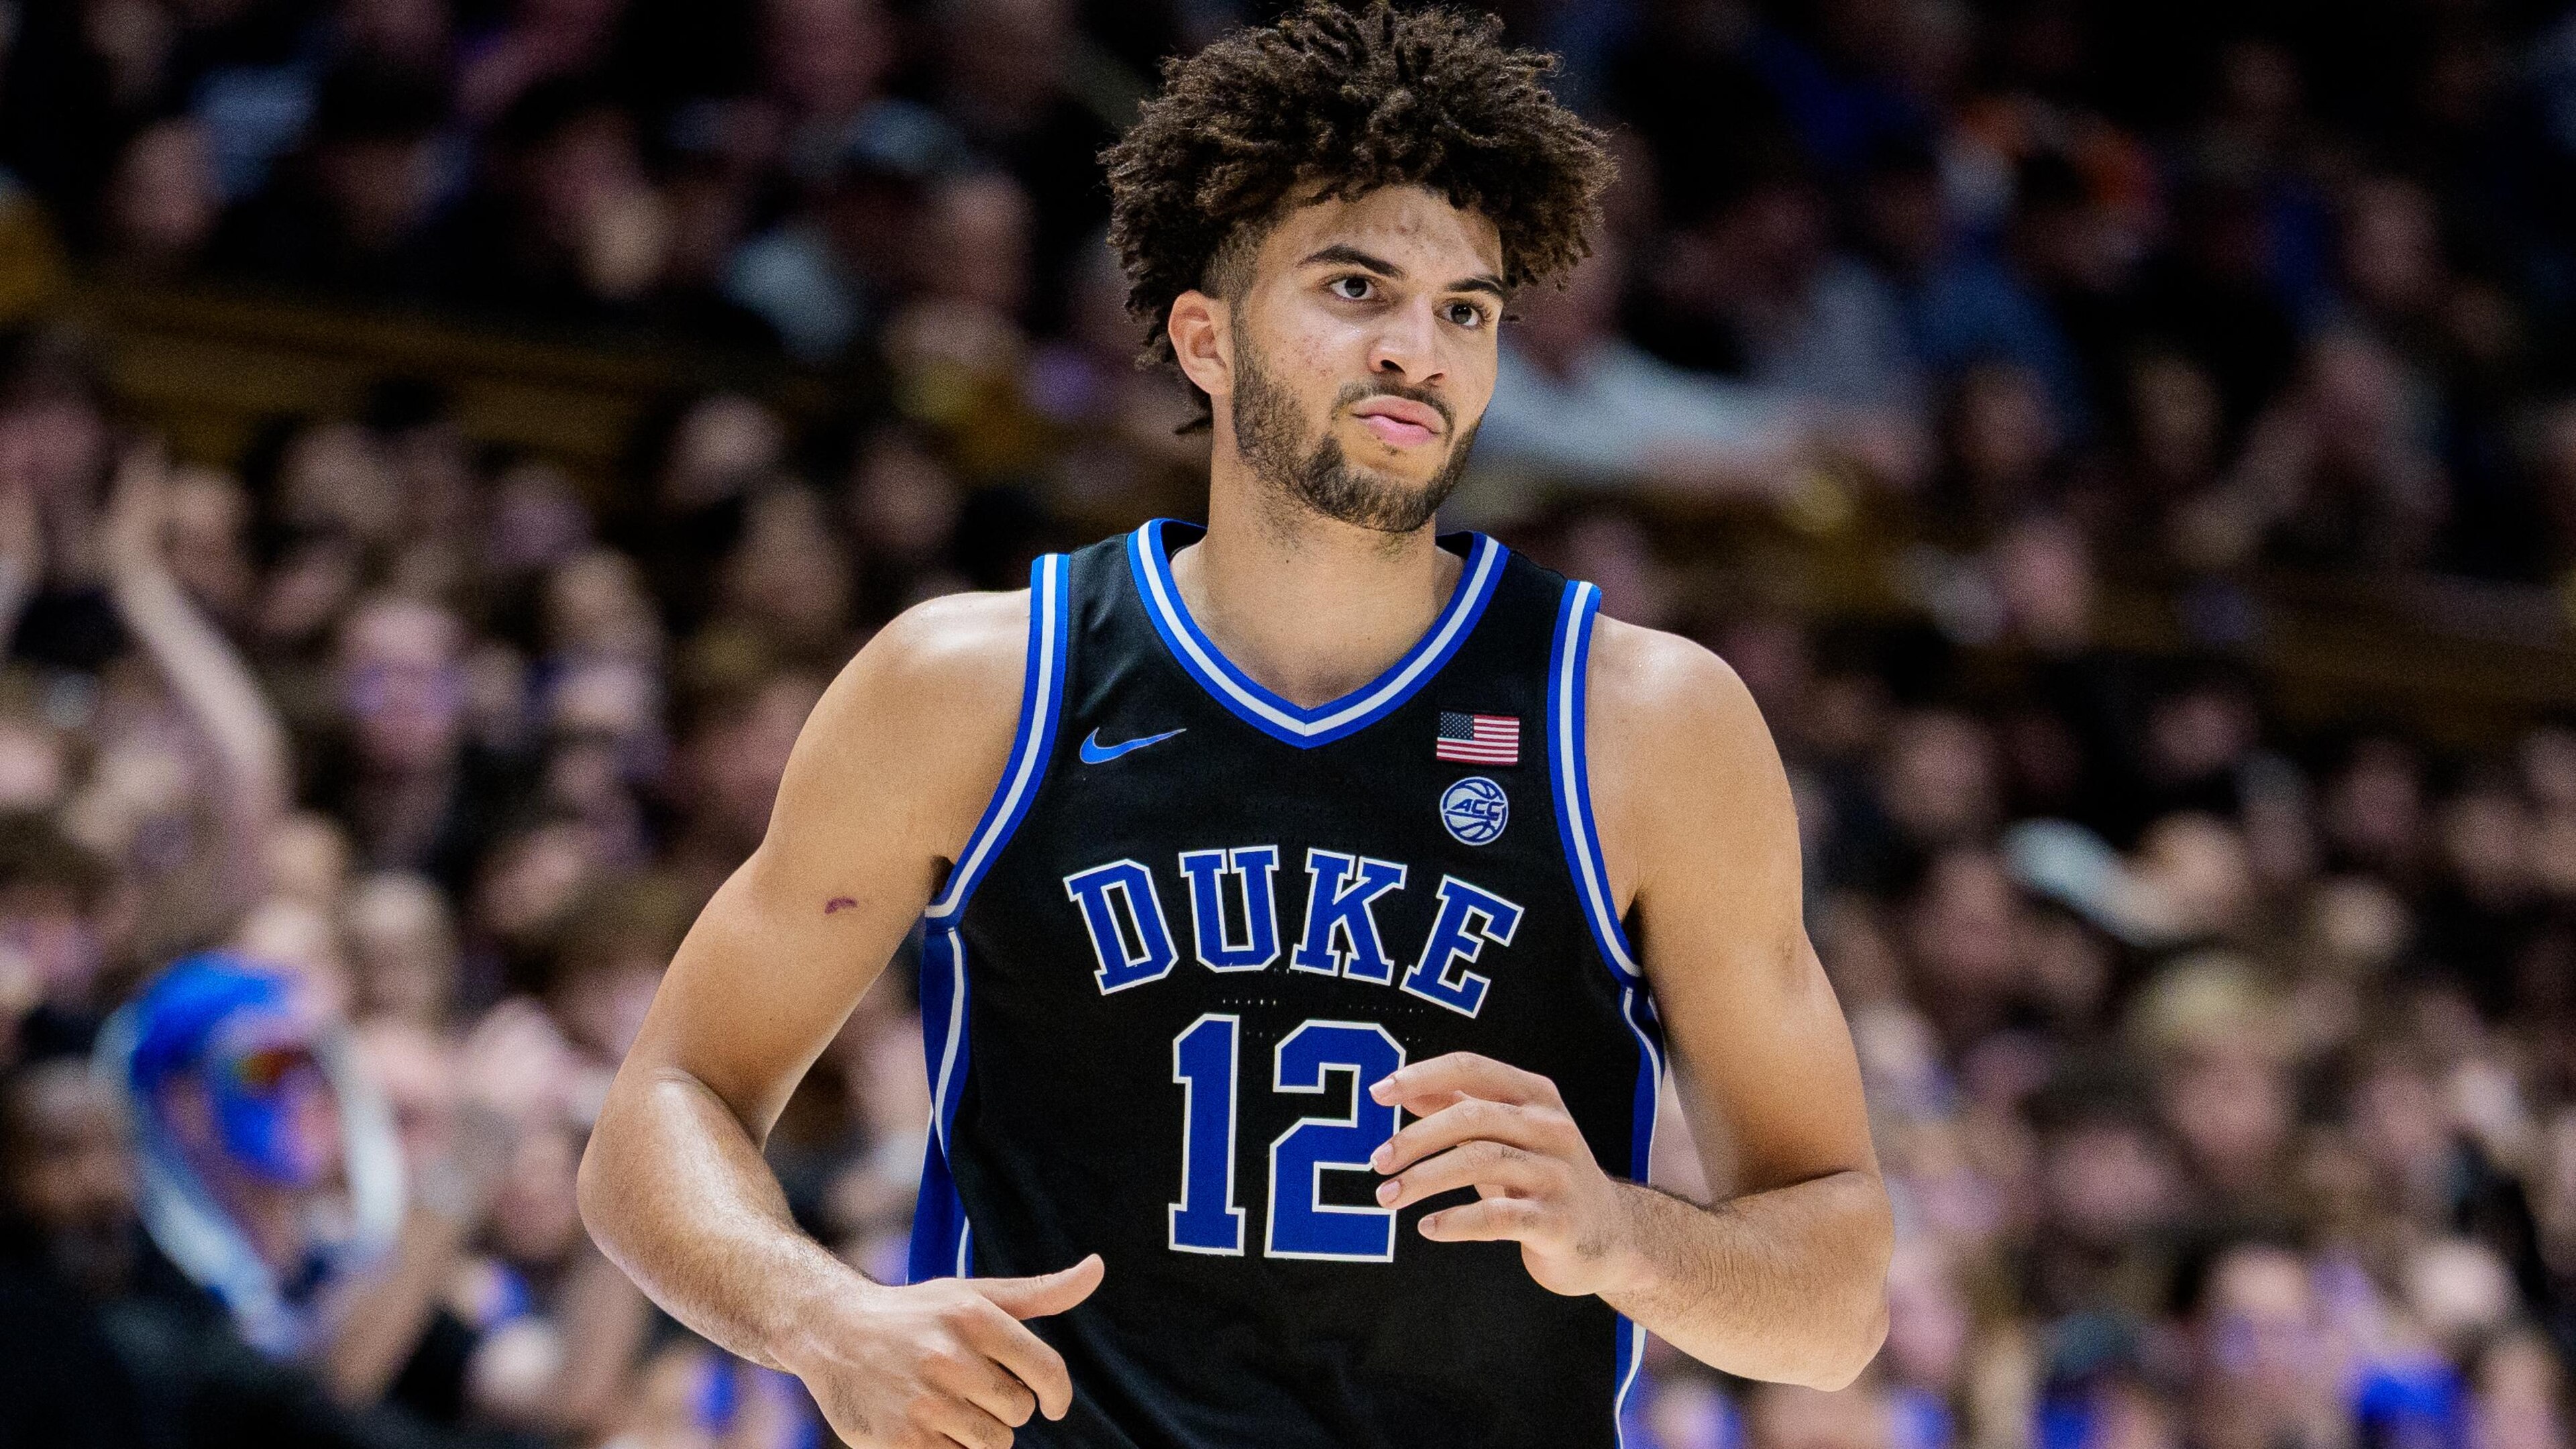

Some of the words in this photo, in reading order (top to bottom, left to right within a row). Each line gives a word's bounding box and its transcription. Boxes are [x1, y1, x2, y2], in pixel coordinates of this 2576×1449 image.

[1451, 798, 1505, 818] ACC
[1063, 845, 1524, 1018] DUKE
[1168, 1013, 1407, 1263] 12
